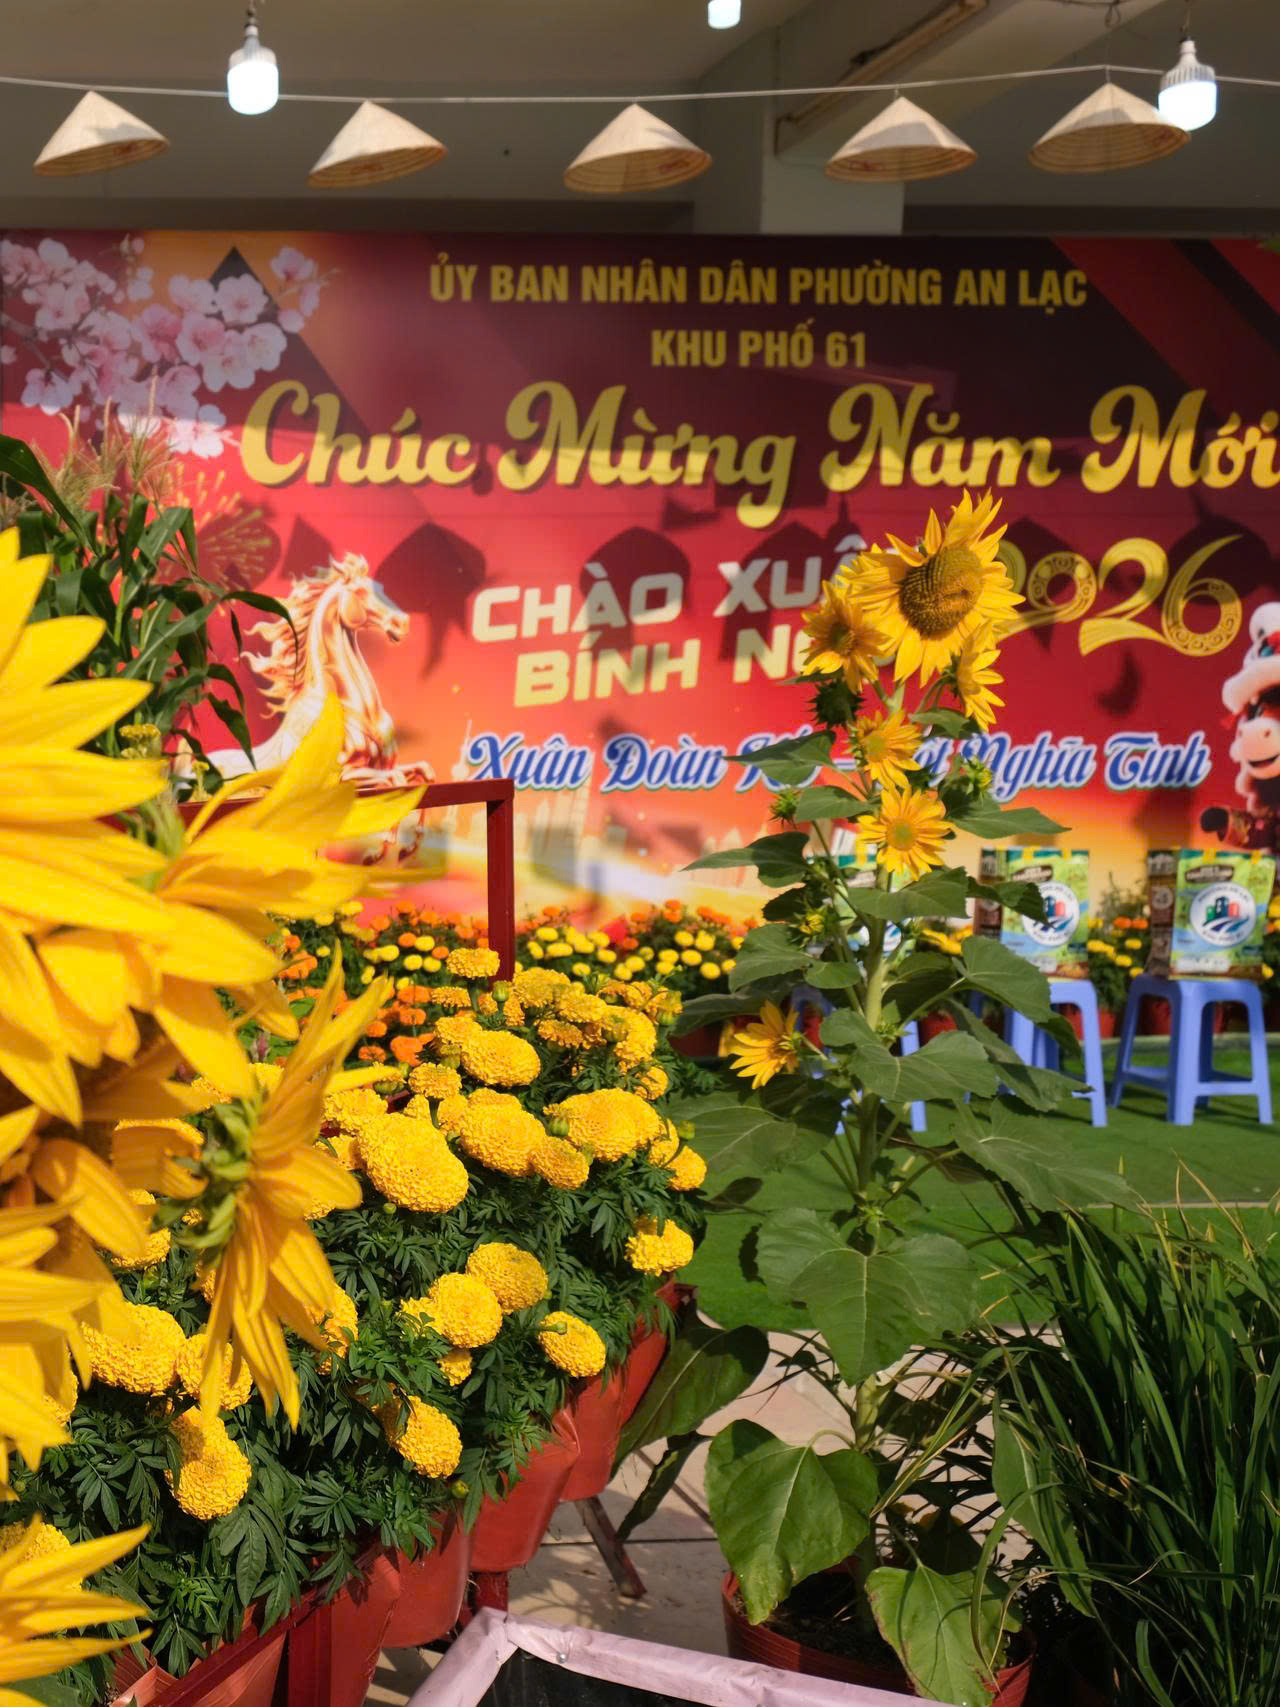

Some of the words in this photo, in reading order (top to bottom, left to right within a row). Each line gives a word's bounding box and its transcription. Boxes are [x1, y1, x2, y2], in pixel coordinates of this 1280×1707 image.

[429, 252, 478, 302] ỦY
[489, 265, 569, 302] BAN
[581, 258, 688, 303] NHÂN
[699, 259, 778, 304] DÂN
[789, 259, 943, 306] PHƯỜNG
[954, 269, 1007, 306] AN
[1017, 269, 1088, 315] LẠC
[651, 329, 727, 368] KHU
[738, 318, 816, 369] PHỐ
[825, 331, 866, 369] 61
[239, 379, 478, 487] Chúc
[496, 380, 797, 529] Mừng
[819, 382, 1062, 493] Năm
[1080, 384, 1280, 494] Mới
[471, 561, 685, 643] CHÀO
[713, 533, 920, 617] XU
[513, 631, 702, 709] BÍNH
[467, 732, 592, 789] Xuân
[601, 732, 728, 791] Đoàn
[960, 731, 1097, 802] Nghĩa
